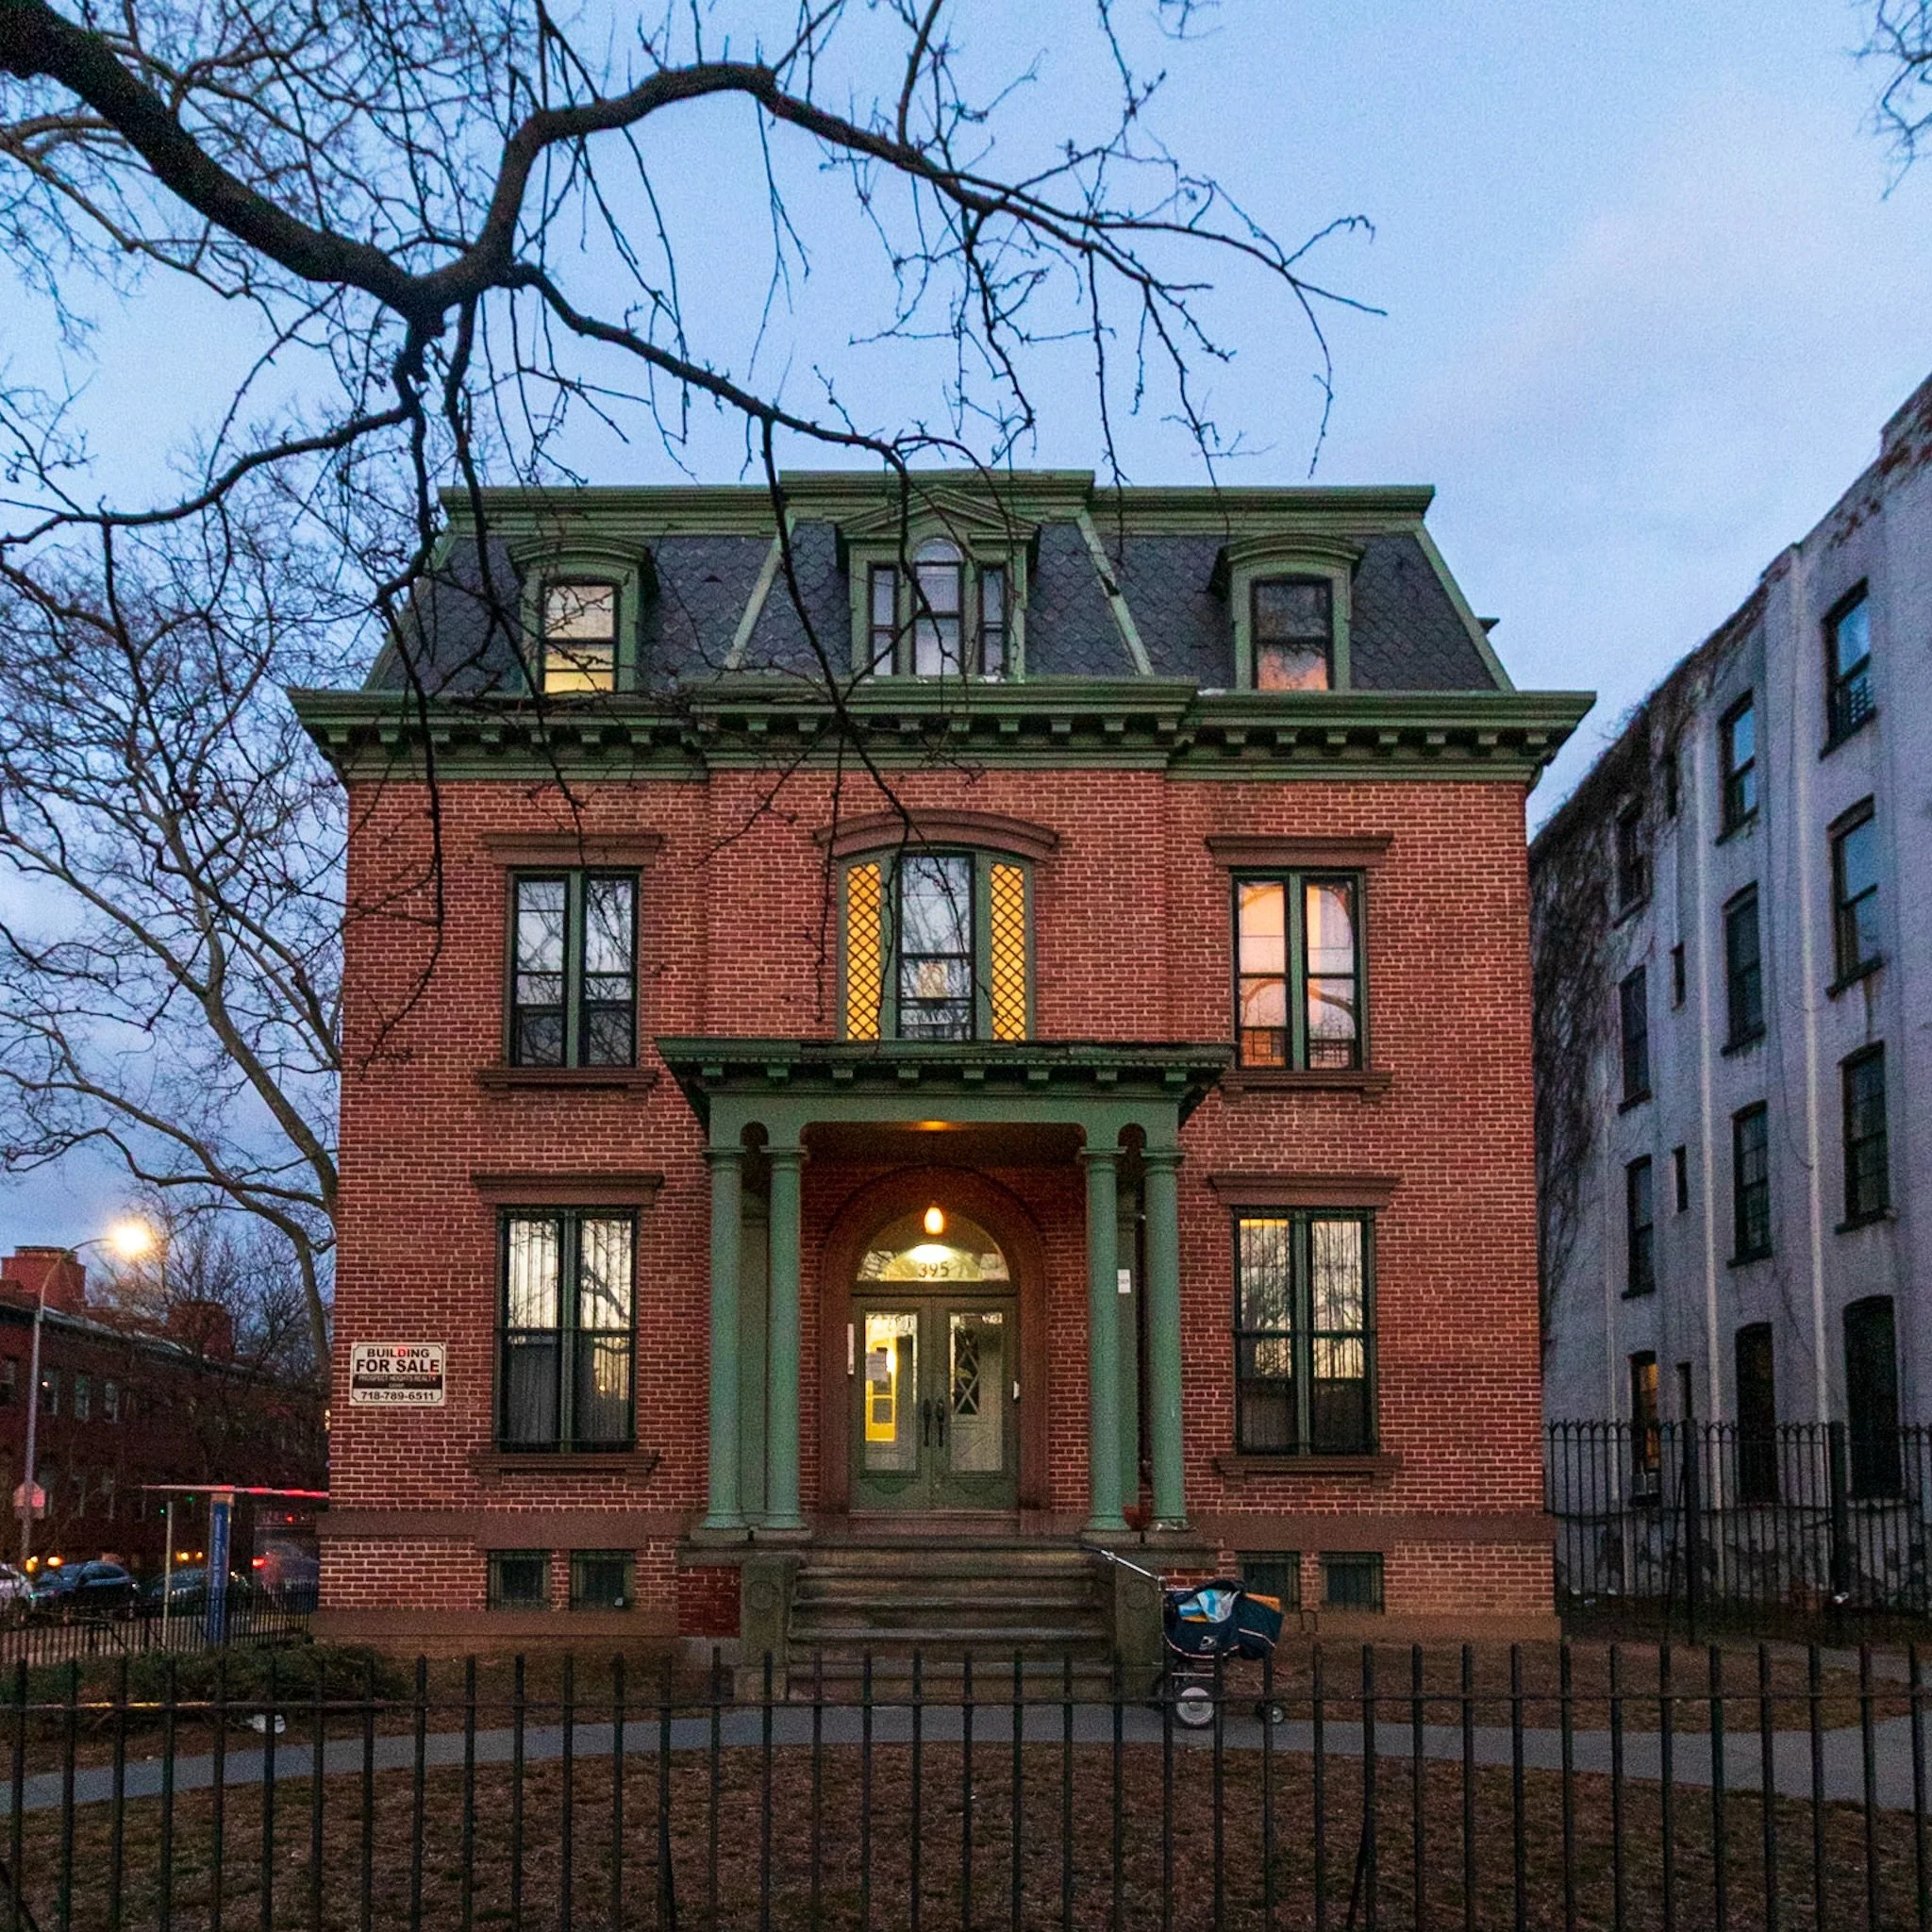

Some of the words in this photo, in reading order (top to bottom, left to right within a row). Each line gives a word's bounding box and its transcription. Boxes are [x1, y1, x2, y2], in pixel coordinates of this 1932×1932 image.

[917, 1260, 950, 1277] 395
[367, 1348, 430, 1357] BUILDING
[357, 1359, 390, 1373] FOR
[396, 1359, 440, 1373] SALE
[361, 1391, 435, 1401] 718-789-6511
